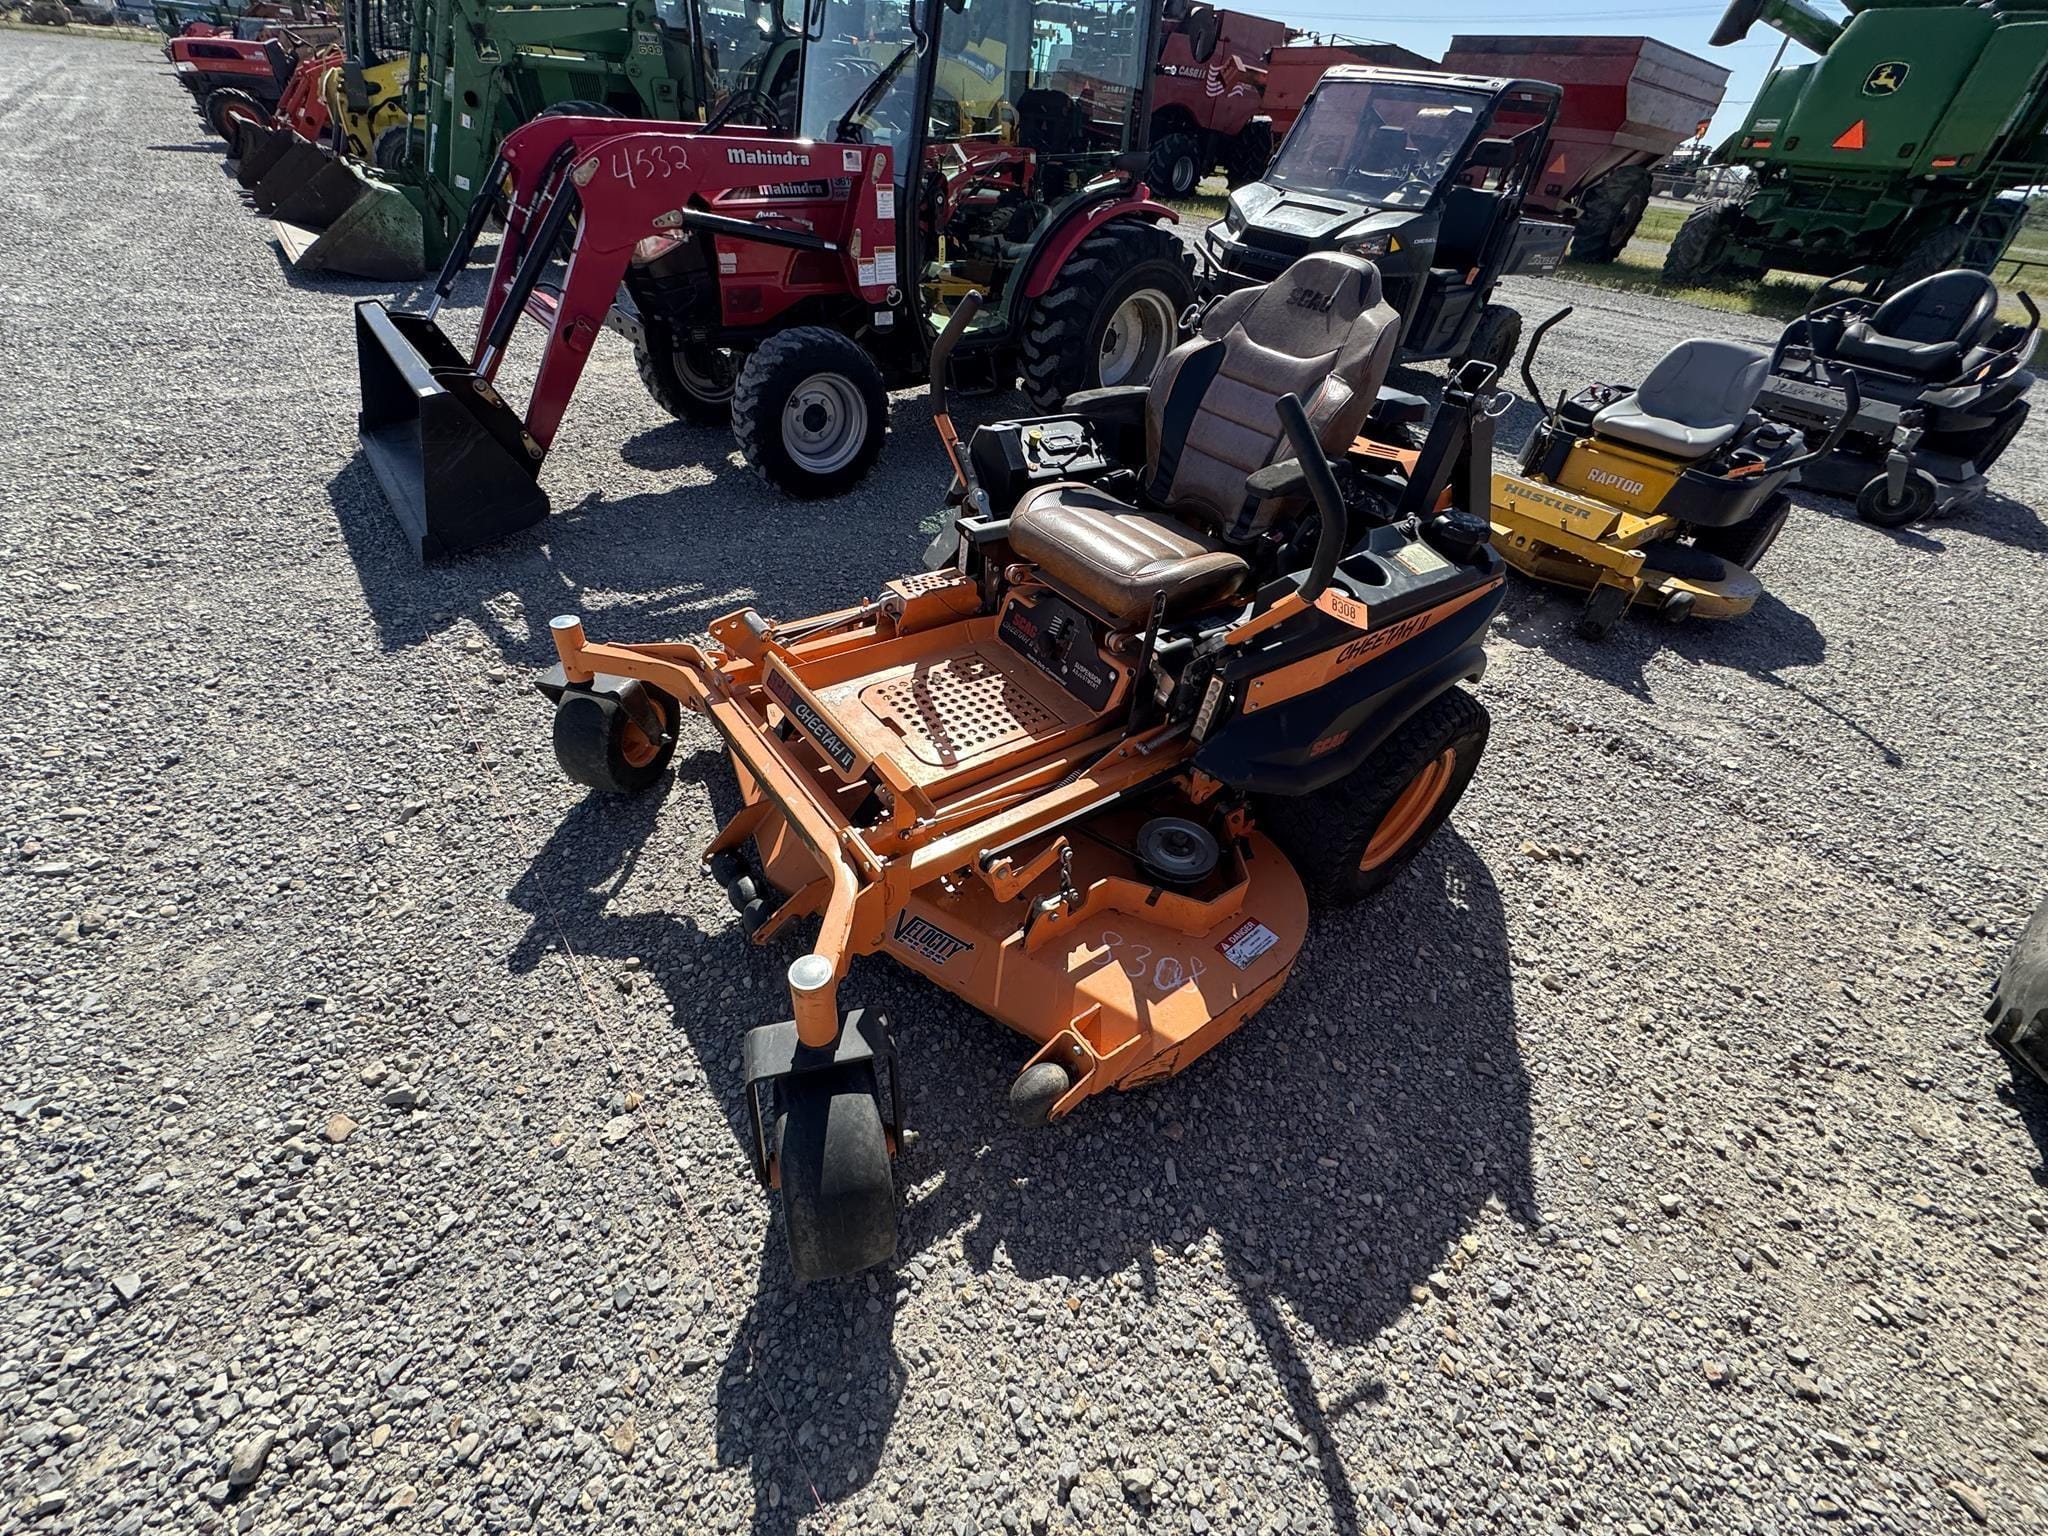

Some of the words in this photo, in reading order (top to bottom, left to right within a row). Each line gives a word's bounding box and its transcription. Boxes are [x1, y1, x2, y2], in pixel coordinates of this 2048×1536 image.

[613, 145, 691, 189] 4532
[727, 148, 810, 166] Mahindra
[758, 182, 823, 196] Mahindra
[1587, 468, 1644, 496] RAPTOR
[1503, 483, 1592, 520] HUSTLER
[1331, 598, 1356, 620] 8308
[1011, 613, 1039, 639] SCAG
[1336, 616, 1420, 664] CHEETAH
[795, 704, 844, 757] CHEETAH
[1228, 921, 1256, 944] DANGER
